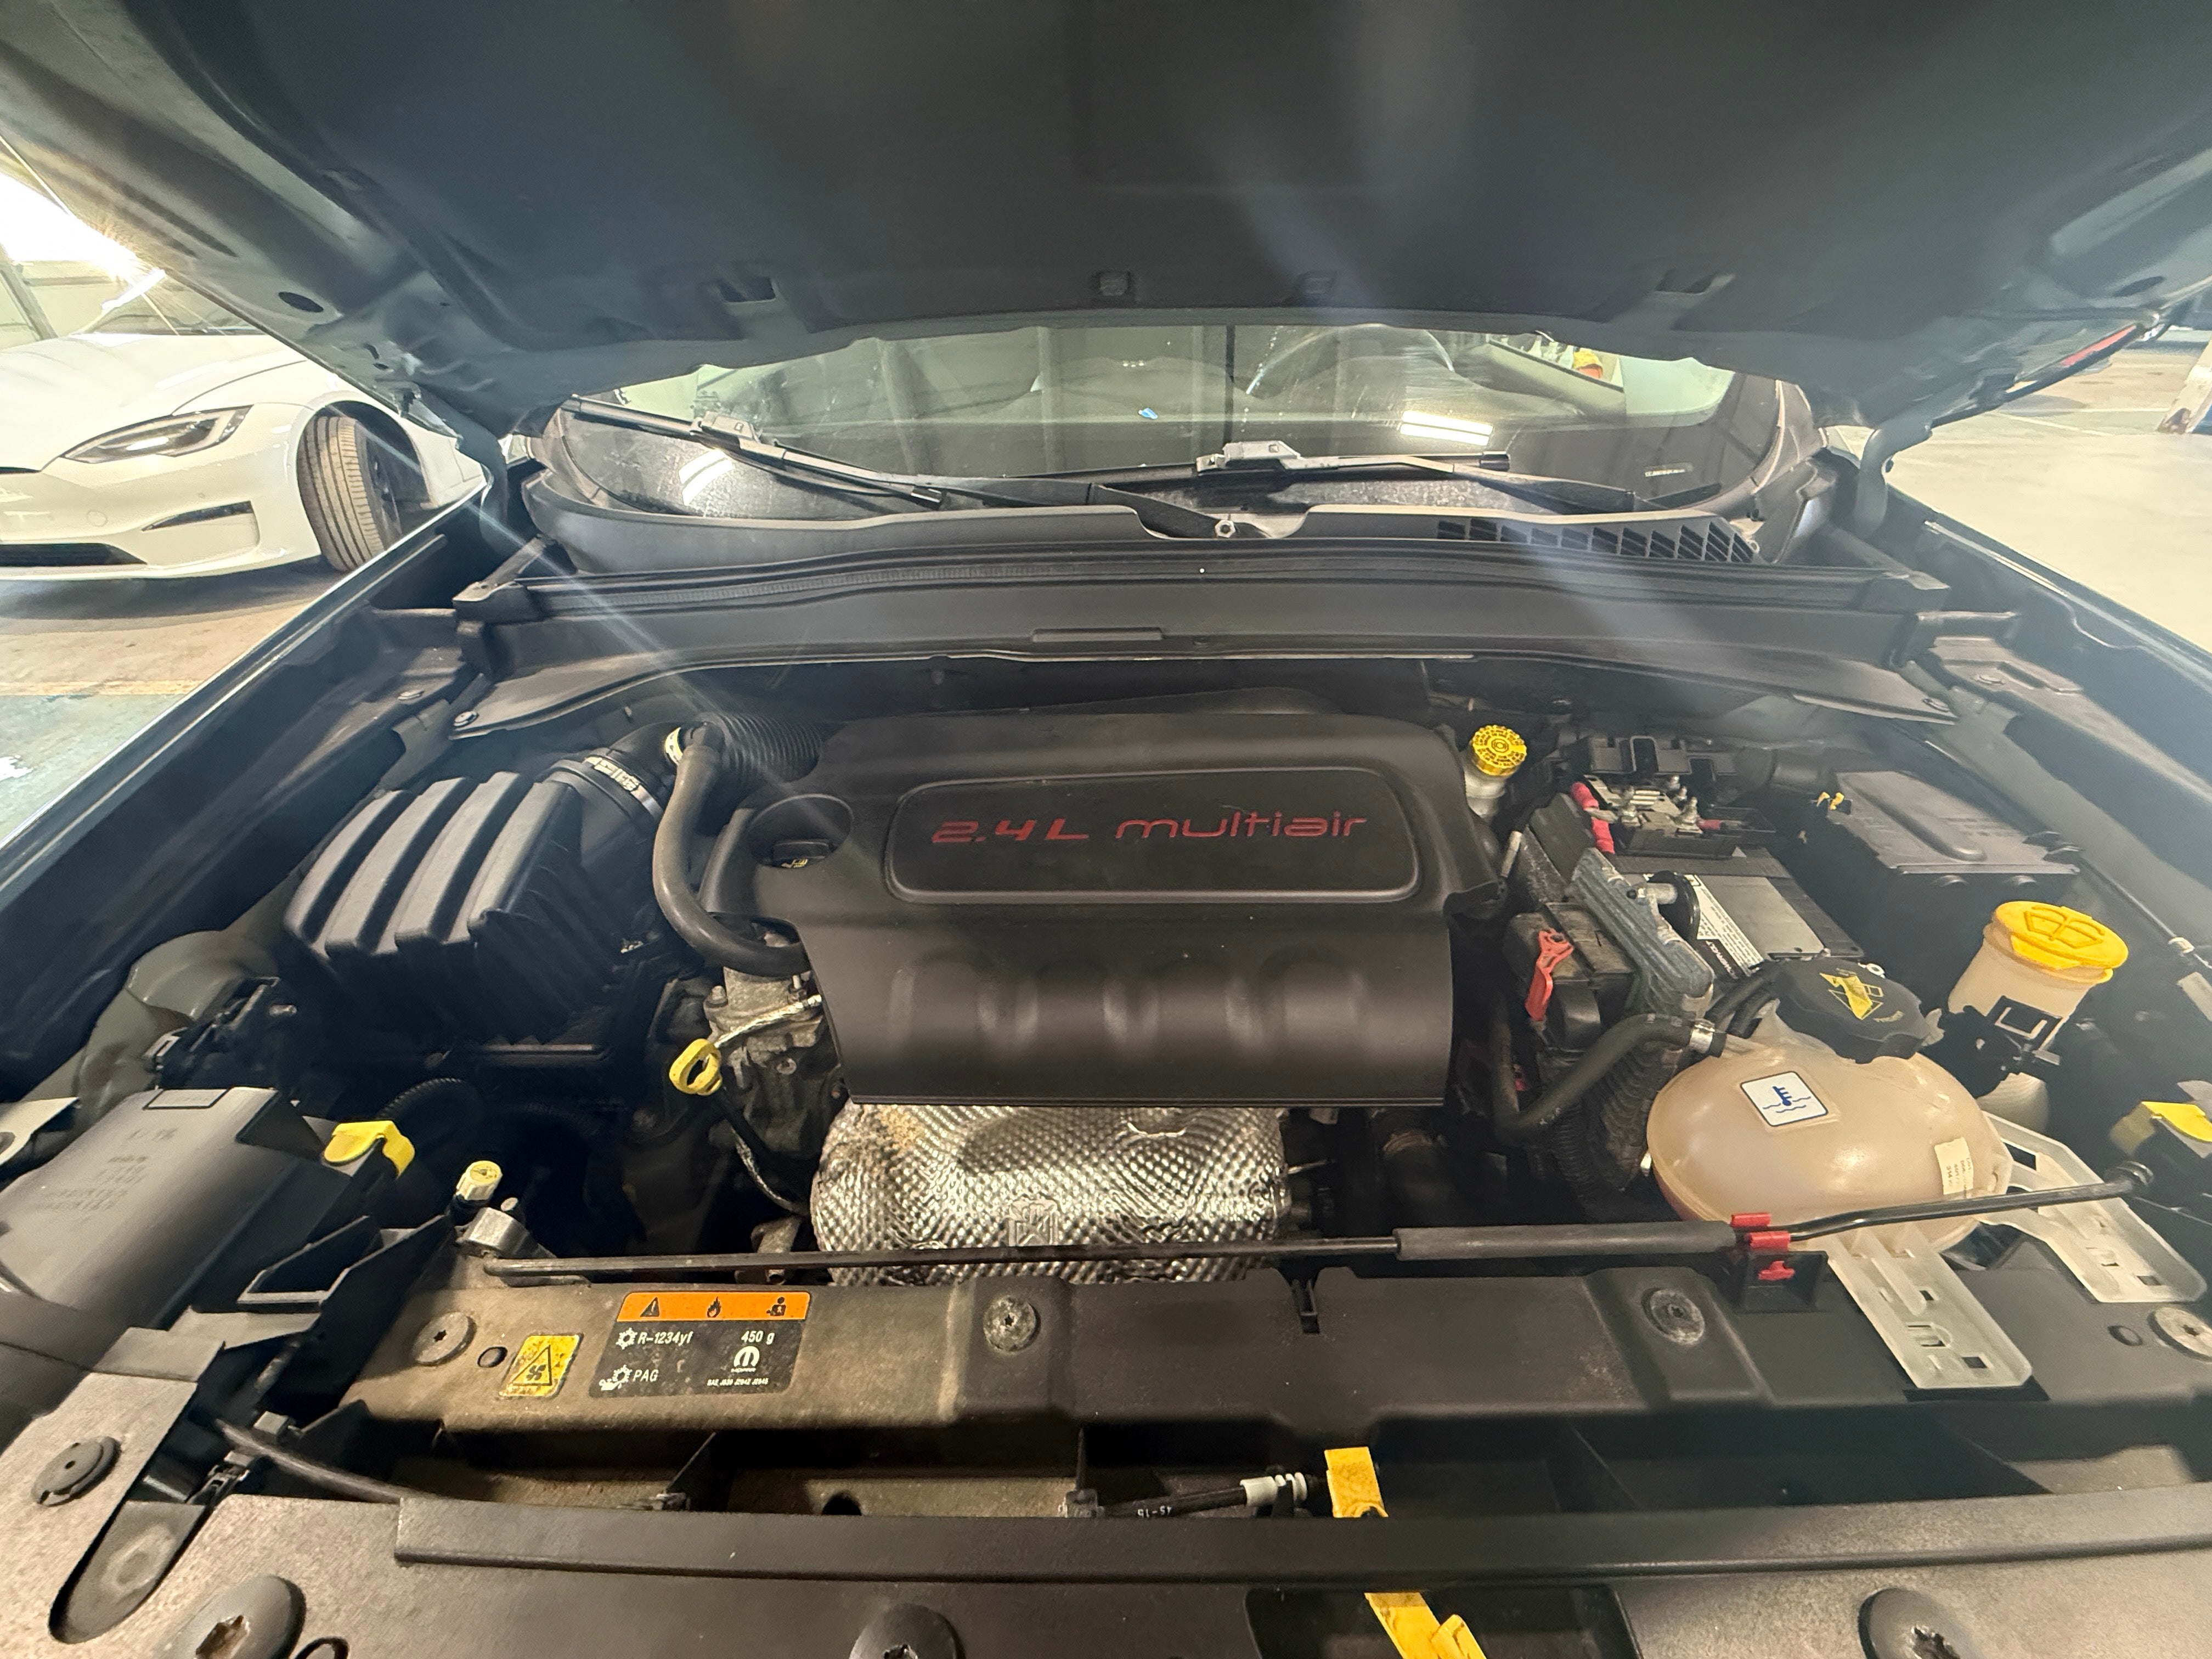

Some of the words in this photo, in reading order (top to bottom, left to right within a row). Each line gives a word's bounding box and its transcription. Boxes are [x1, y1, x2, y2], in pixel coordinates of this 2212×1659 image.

[1115, 811, 1367, 839] multiair
[637, 1330, 694, 1347] R-1234yf
[741, 1330, 764, 1343] 450
[766, 1332, 775, 1345] g
[632, 1369, 659, 1383] PAG
